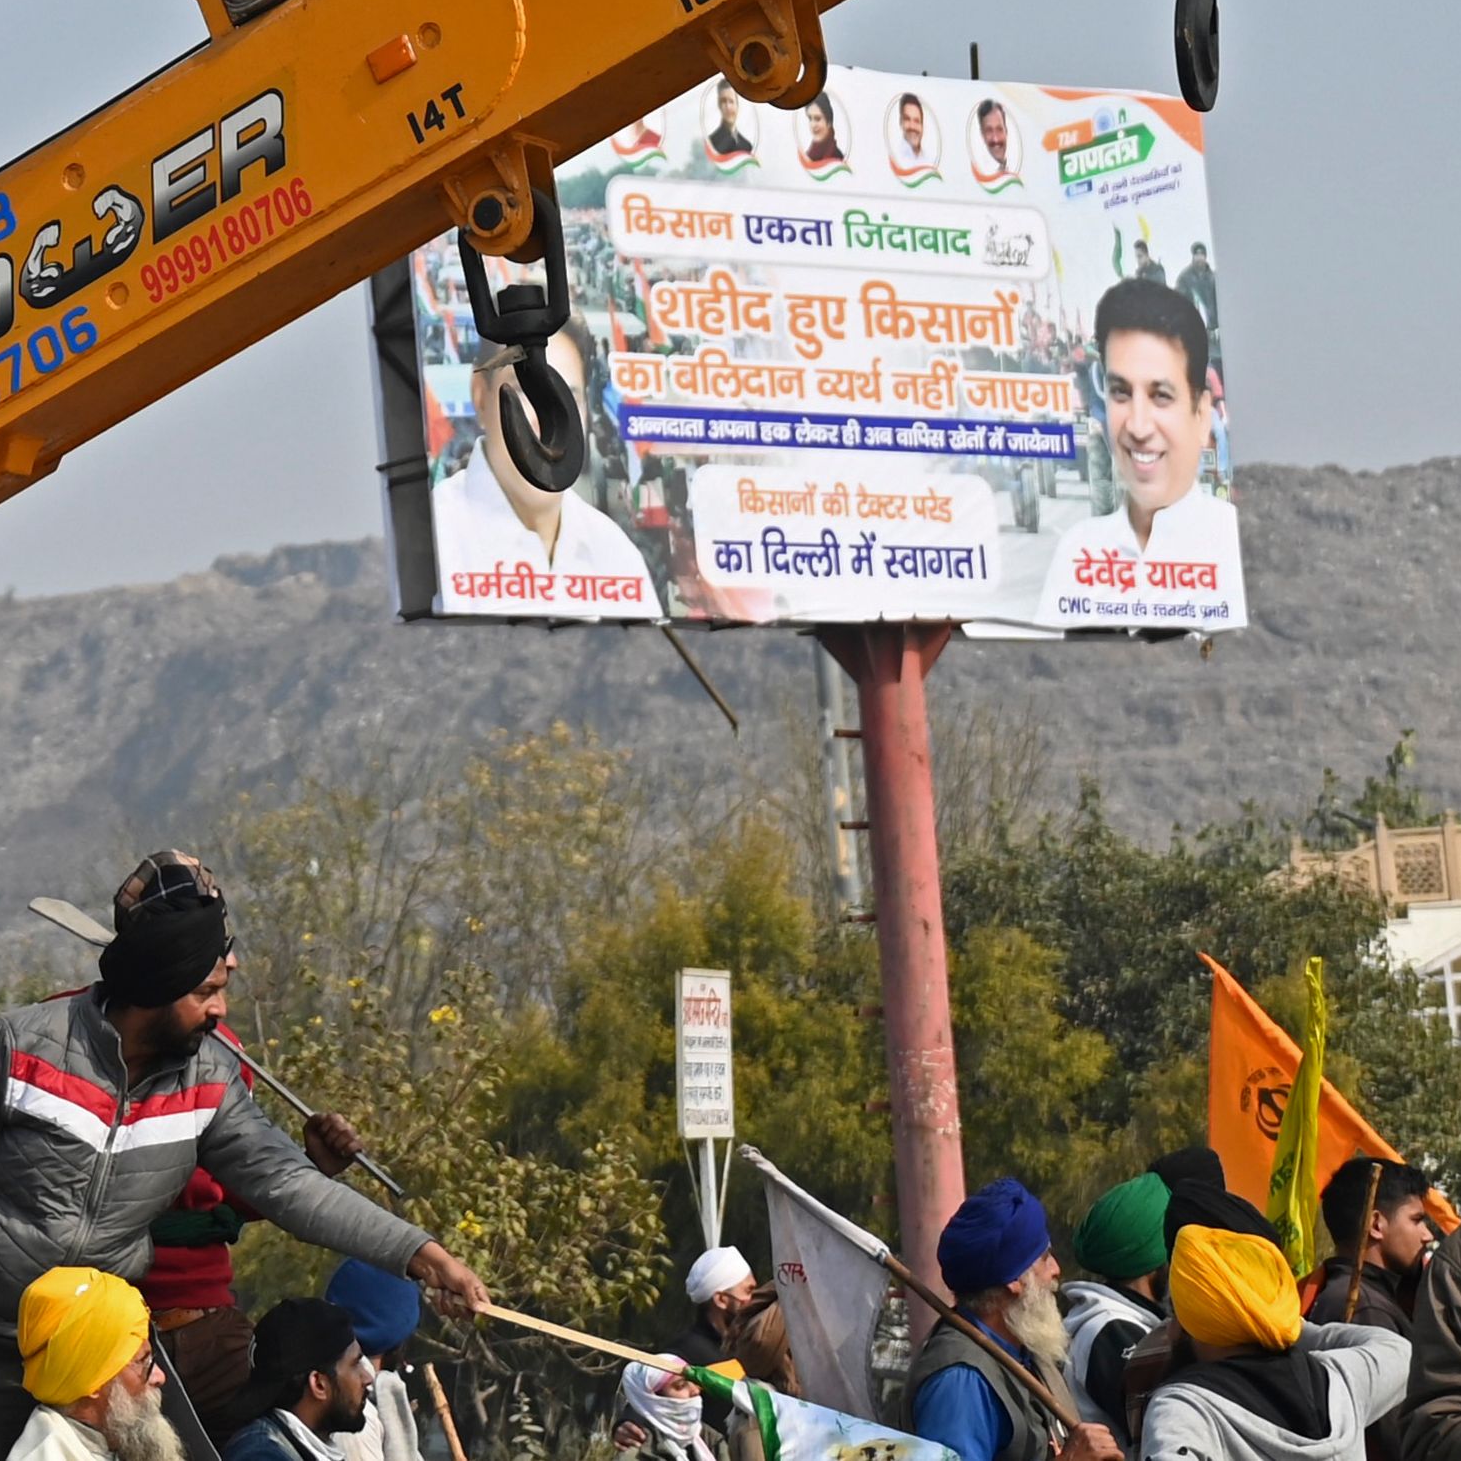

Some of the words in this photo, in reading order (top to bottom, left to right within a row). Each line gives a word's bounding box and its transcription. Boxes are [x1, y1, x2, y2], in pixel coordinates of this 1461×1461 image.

[406, 82, 466, 145] 14T
[1063, 129, 1139, 177] गणतंत्र
[140, 176, 313, 304] 9999180706
[622, 193, 734, 240] किसान
[742, 214, 833, 247] एकता
[842, 209, 972, 256] जिंदाबाद
[656, 270, 773, 335] शहीद
[784, 294, 848, 360] हुए
[860, 280, 1020, 346] किसानों
[614, 359, 663, 393] का
[814, 357, 882, 403] व्यर्थ
[891, 359, 959, 410] नहीं
[963, 375, 1072, 412] जाएगा
[627, 415, 706, 438] अन्नदाता
[708, 418, 757, 441] अपना
[759, 421, 793, 443] हक
[794, 417, 840, 444] लेकर
[841, 417, 861, 446] ही
[864, 425, 893, 446] अब
[895, 420, 946, 449] वापिस
[948, 424, 987, 451] खेतों
[988, 425, 1006, 452] में
[737, 478, 818, 516] किसानों
[820, 481, 850, 517] की
[912, 487, 953, 524] परेड
[712, 538, 753, 574] का
[760, 525, 841, 578] दिल्ली
[849, 530, 877, 577] में
[1072, 547, 1138, 594] देवेंद्र
[1144, 560, 1218, 590] यादव
[451, 560, 556, 601] धर्मवीर
[564, 574, 645, 603] यादव
[1058, 596, 1091, 614] CWC
